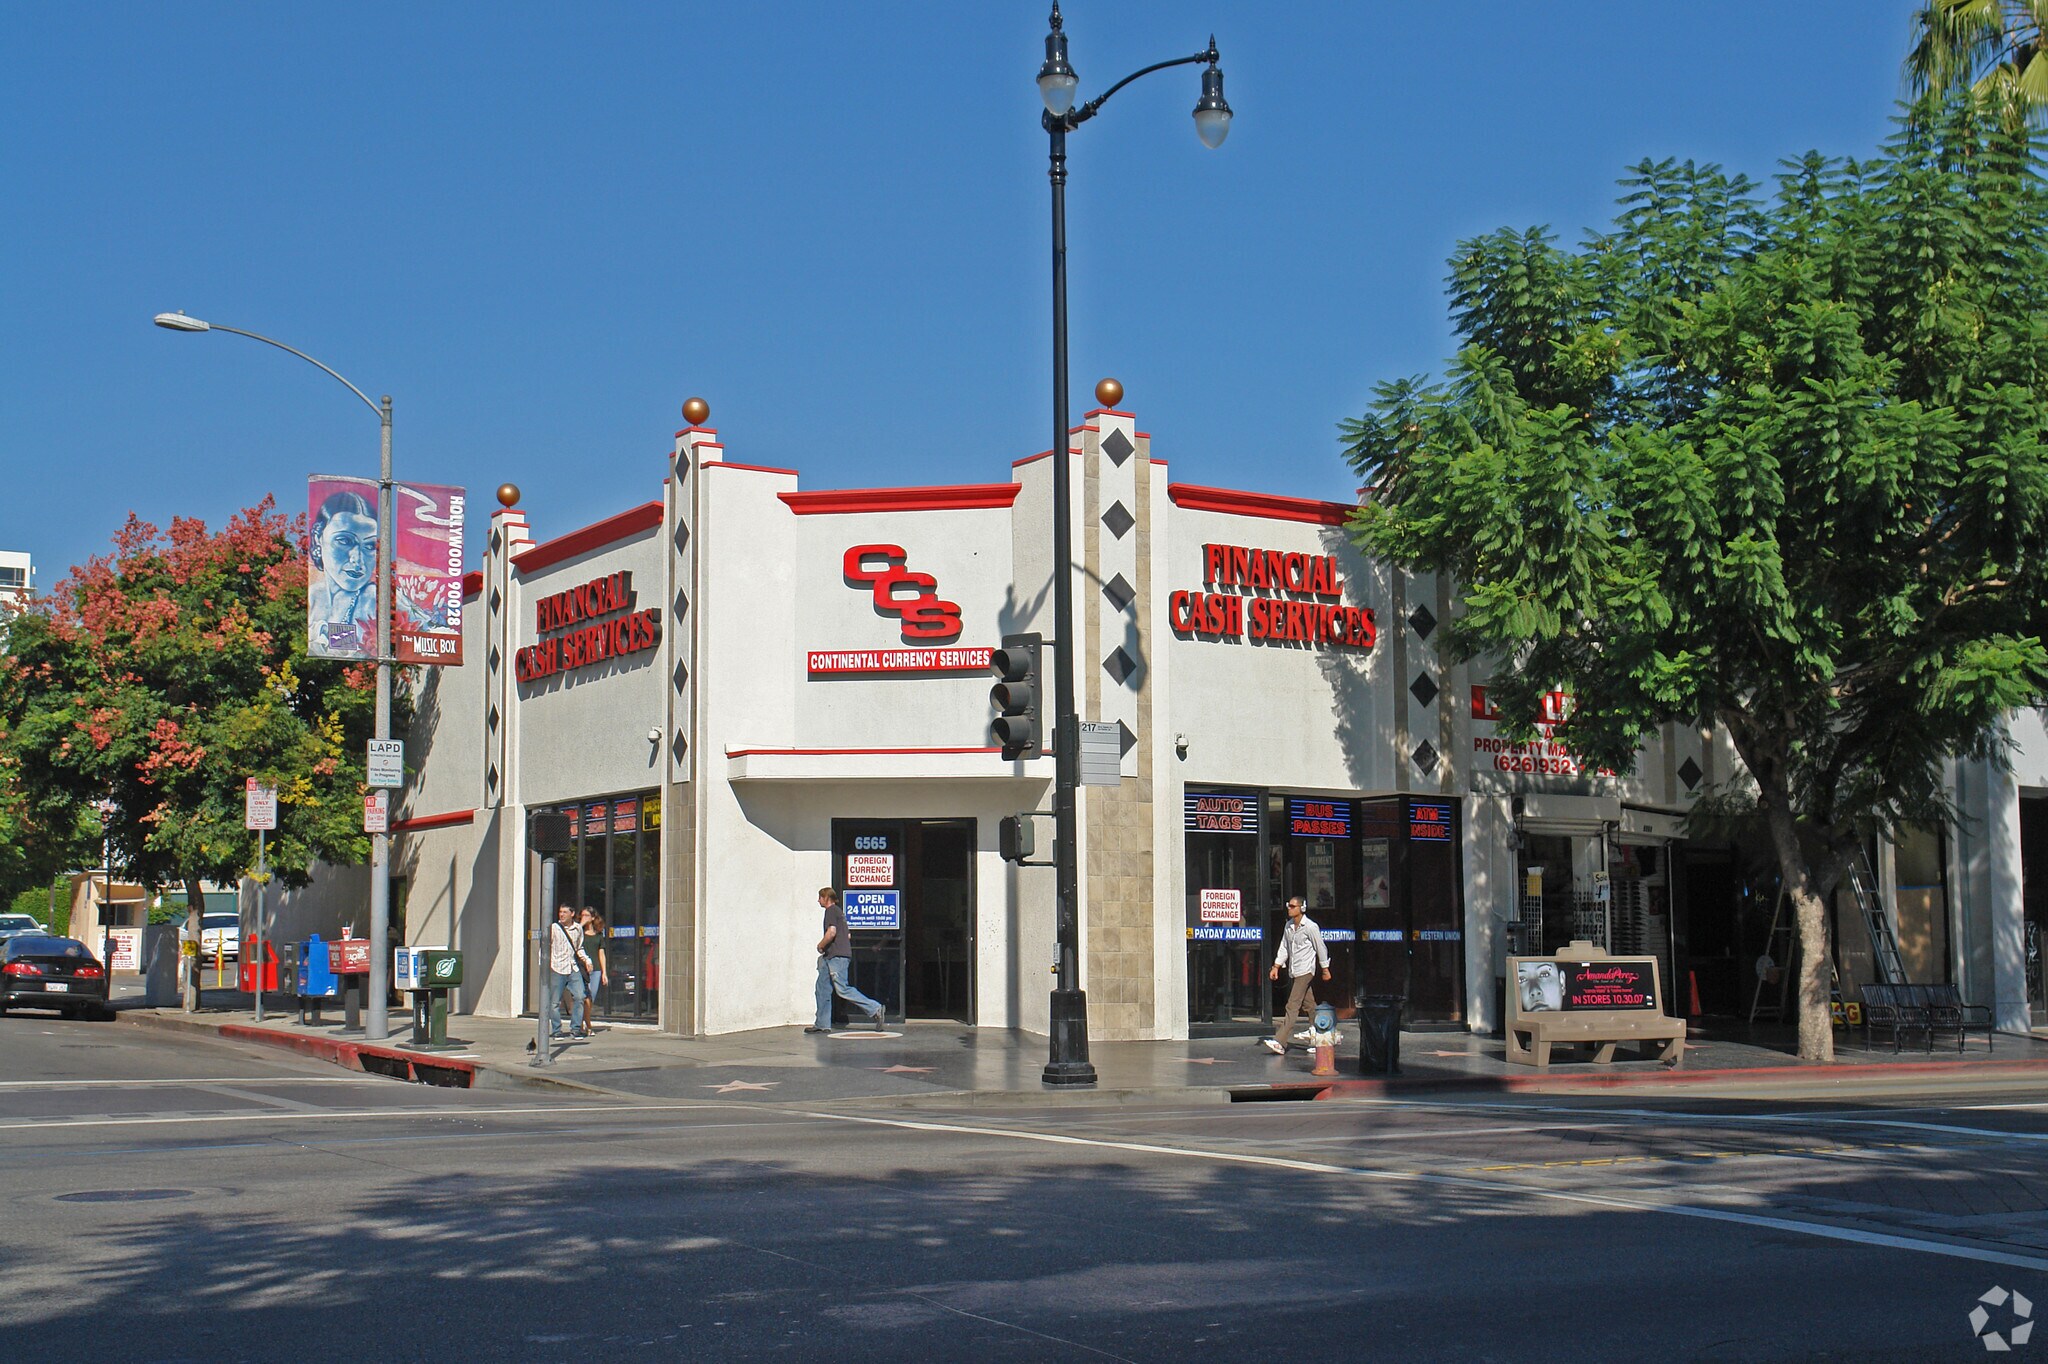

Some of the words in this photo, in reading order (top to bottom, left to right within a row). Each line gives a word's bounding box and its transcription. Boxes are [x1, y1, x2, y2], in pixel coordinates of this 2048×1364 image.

[448, 495, 465, 577] HOLLYWOOD
[1206, 543, 1344, 596] FINANCIAL
[844, 544, 962, 639] CCS
[447, 581, 461, 626] 90028
[536, 570, 630, 634] FINANCIAL
[1172, 589, 1244, 636] CASH
[1251, 597, 1377, 648] SERVICES
[413, 636, 437, 653] MUSIC
[440, 639, 456, 654] BOX
[515, 638, 558, 683] CASH
[562, 608, 657, 671] SERVICES
[811, 653, 880, 669] CONTINENTAL
[882, 652, 937, 668] CURRENCY
[939, 650, 990, 666] SERVICES
[1081, 723, 1096, 732] 217
[370, 743, 400, 752] LAPD
[1197, 798, 1244, 812] AUTO
[1305, 803, 1334, 818] BUS
[1416, 808, 1439, 820] ATM
[1197, 815, 1242, 830] TAGS
[1294, 820, 1346, 835] PASSES
[1410, 824, 1445, 837] INSIDE
[855, 837, 887, 850] 6565
[858, 895, 884, 904] OPEN
[1206, 892, 1235, 900] FOREIGN
[847, 905, 858, 914] 24
[862, 905, 896, 914] HOURS
[1195, 928, 1224, 939] PAYDAY
[1226, 928, 1262, 939] ADVANCE
[1321, 930, 1356, 940] EGISTRATION
[1420, 930, 1443, 940] WESTERN
[1445, 930, 1460, 940] UNION
[1572, 995, 1582, 1004] IN
[1583, 995, 1611, 1004] STORES
[1613, 995, 1643, 1004] 10.30.07
